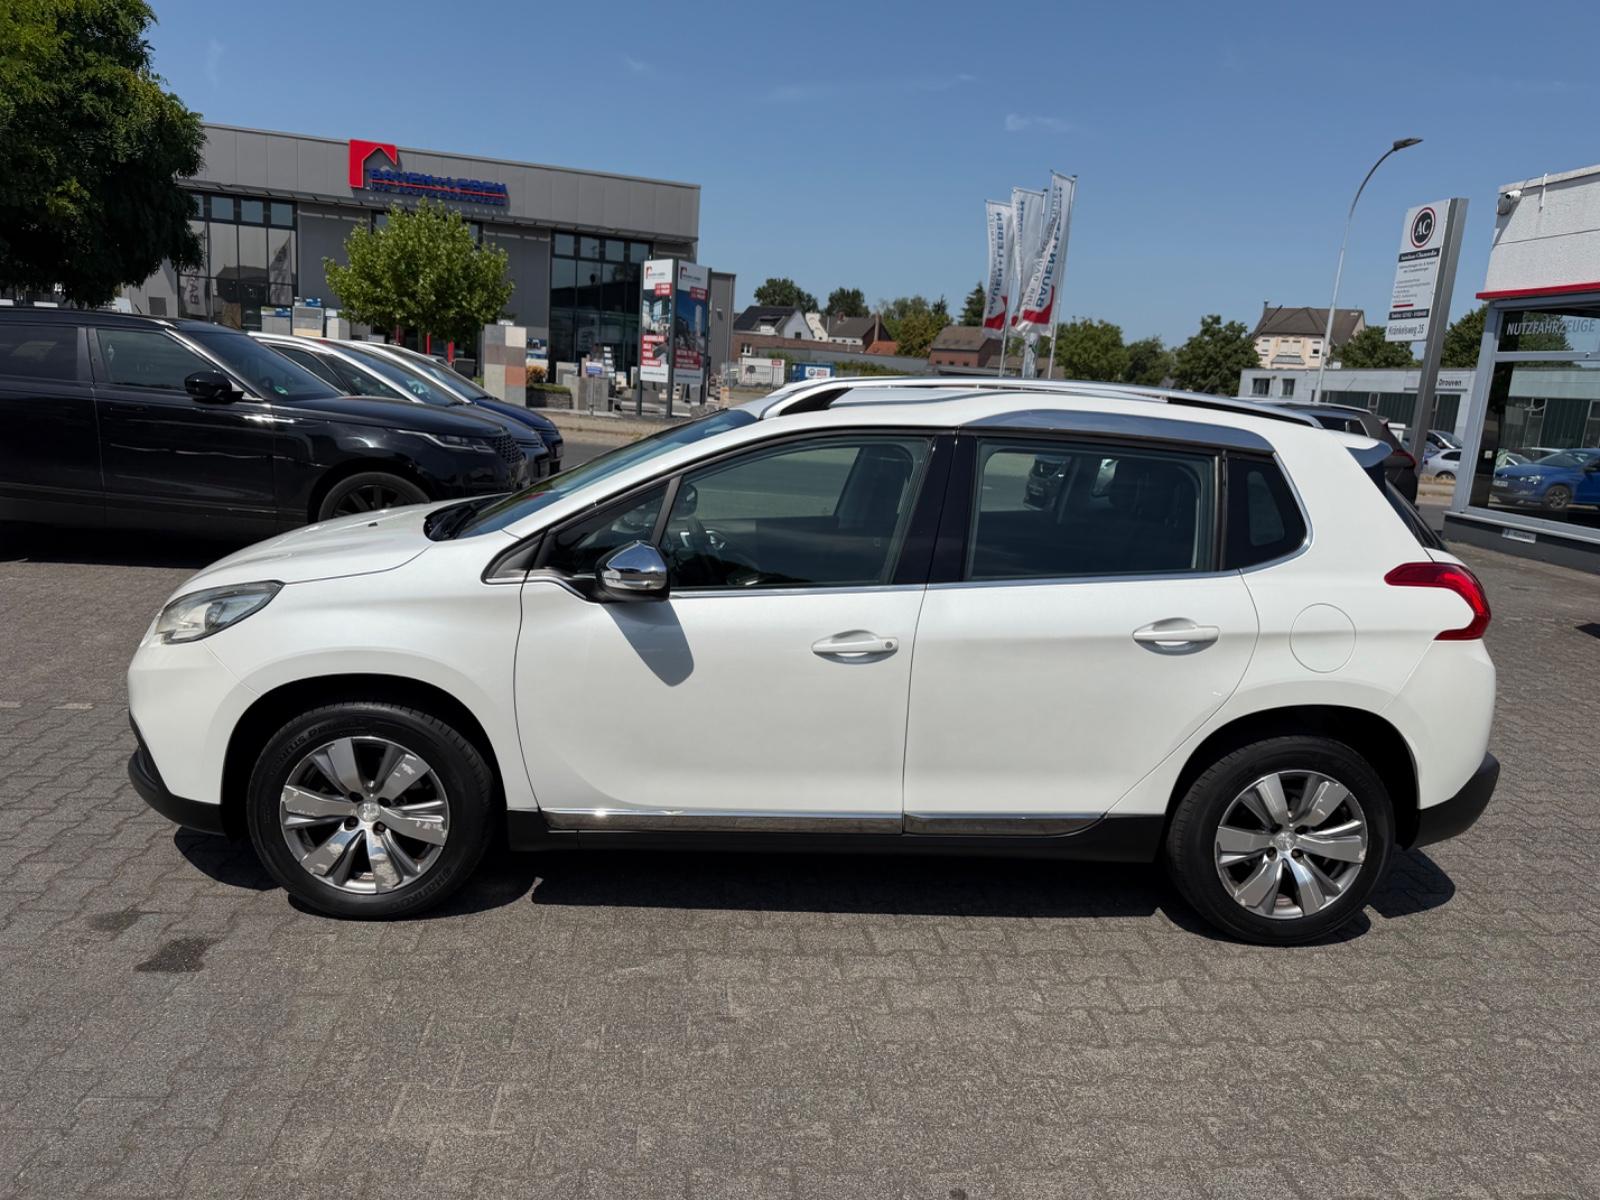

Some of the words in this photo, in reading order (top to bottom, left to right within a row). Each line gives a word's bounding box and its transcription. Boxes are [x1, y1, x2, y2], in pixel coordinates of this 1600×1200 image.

[1415, 219, 1431, 236] AC
[1506, 319, 1595, 336] NUTZFAHRZEUGE
[1438, 378, 1462, 387] Drouven
